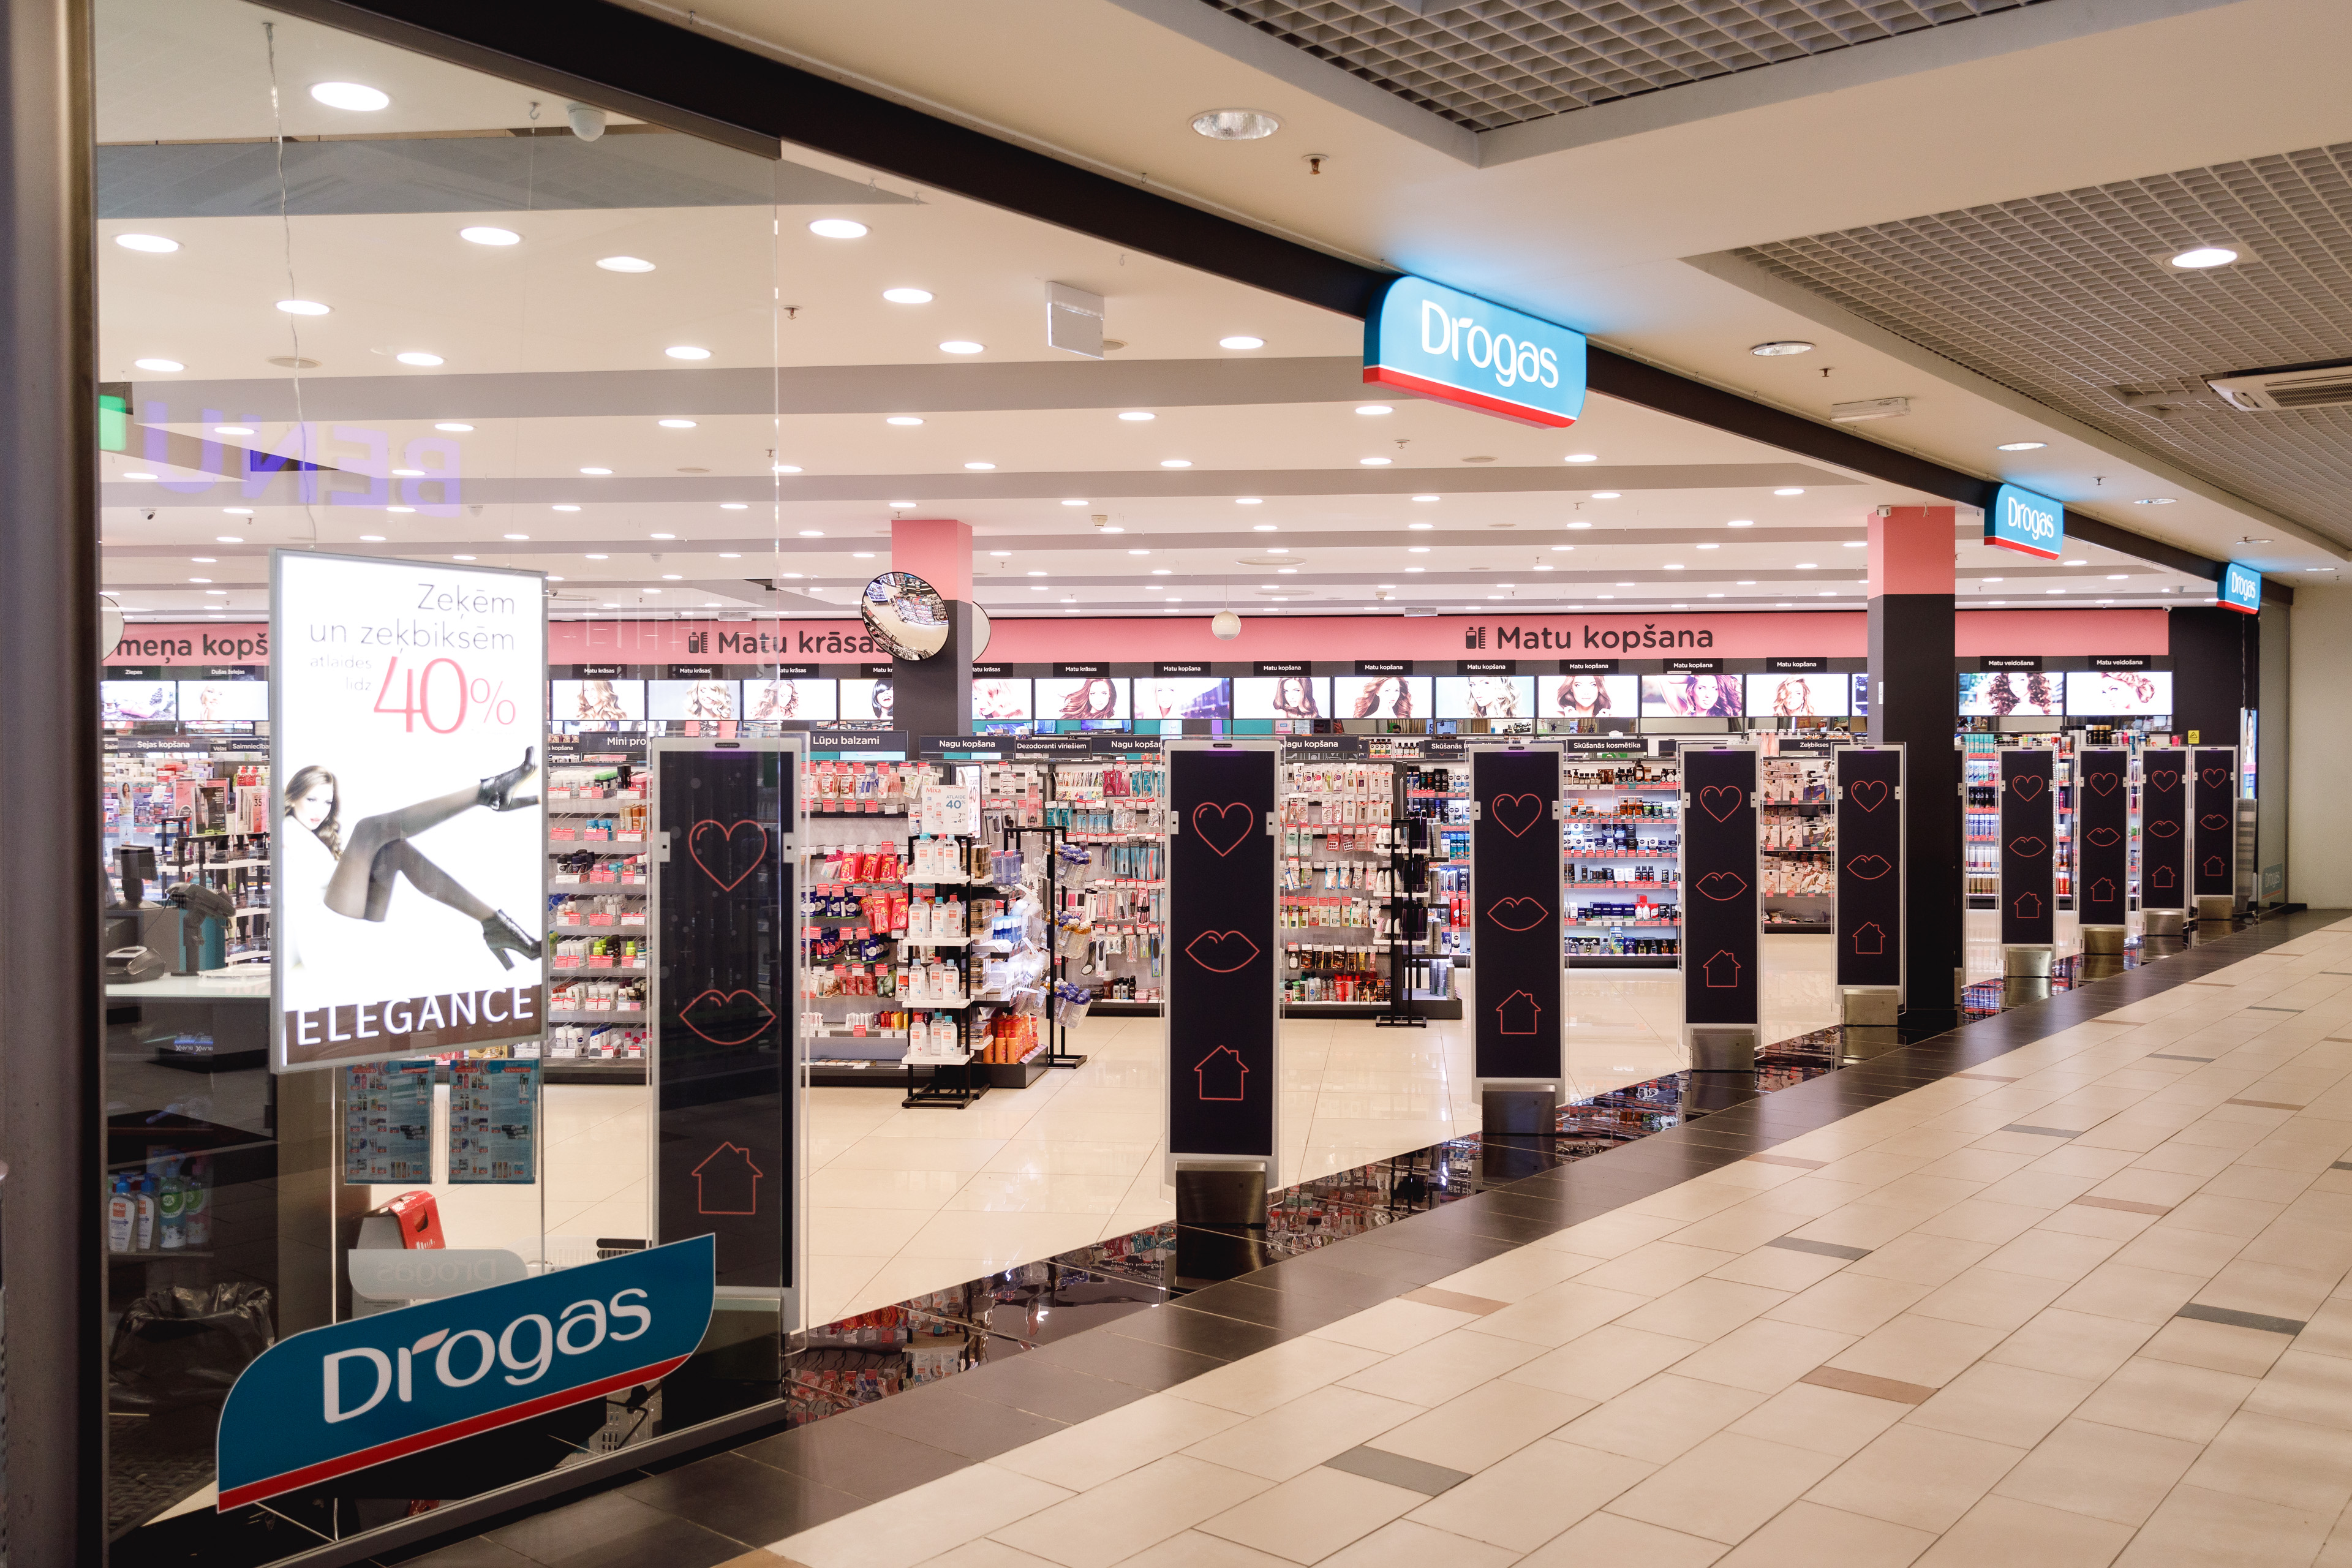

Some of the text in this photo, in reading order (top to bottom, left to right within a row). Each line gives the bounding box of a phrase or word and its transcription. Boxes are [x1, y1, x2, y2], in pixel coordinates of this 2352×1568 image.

[1422, 299, 1558, 388] Drogas
[2008, 497, 2053, 540] Drogas
[2231, 571, 2255, 601] Drogas
[417, 583, 514, 619] Zeķēm
[203, 633, 268, 660] kopš
[310, 618, 514, 654] un zeķbiksēm
[718, 632, 786, 654] Matu
[1498, 624, 1713, 653] Matu kopšana
[311, 655, 372, 669] atlaides
[159, 741, 190, 749] kopšana
[607, 737, 627, 745] Mini
[813, 736, 880, 747] Lūpu balzami
[939, 740, 995, 750] Nagu kopšana
[1111, 741, 1134, 750] Nagu
[1304, 740, 1338, 749] kopšana
[297, 984, 534, 1046] ELEGANCE
[323, 1287, 652, 1424] Drogas
